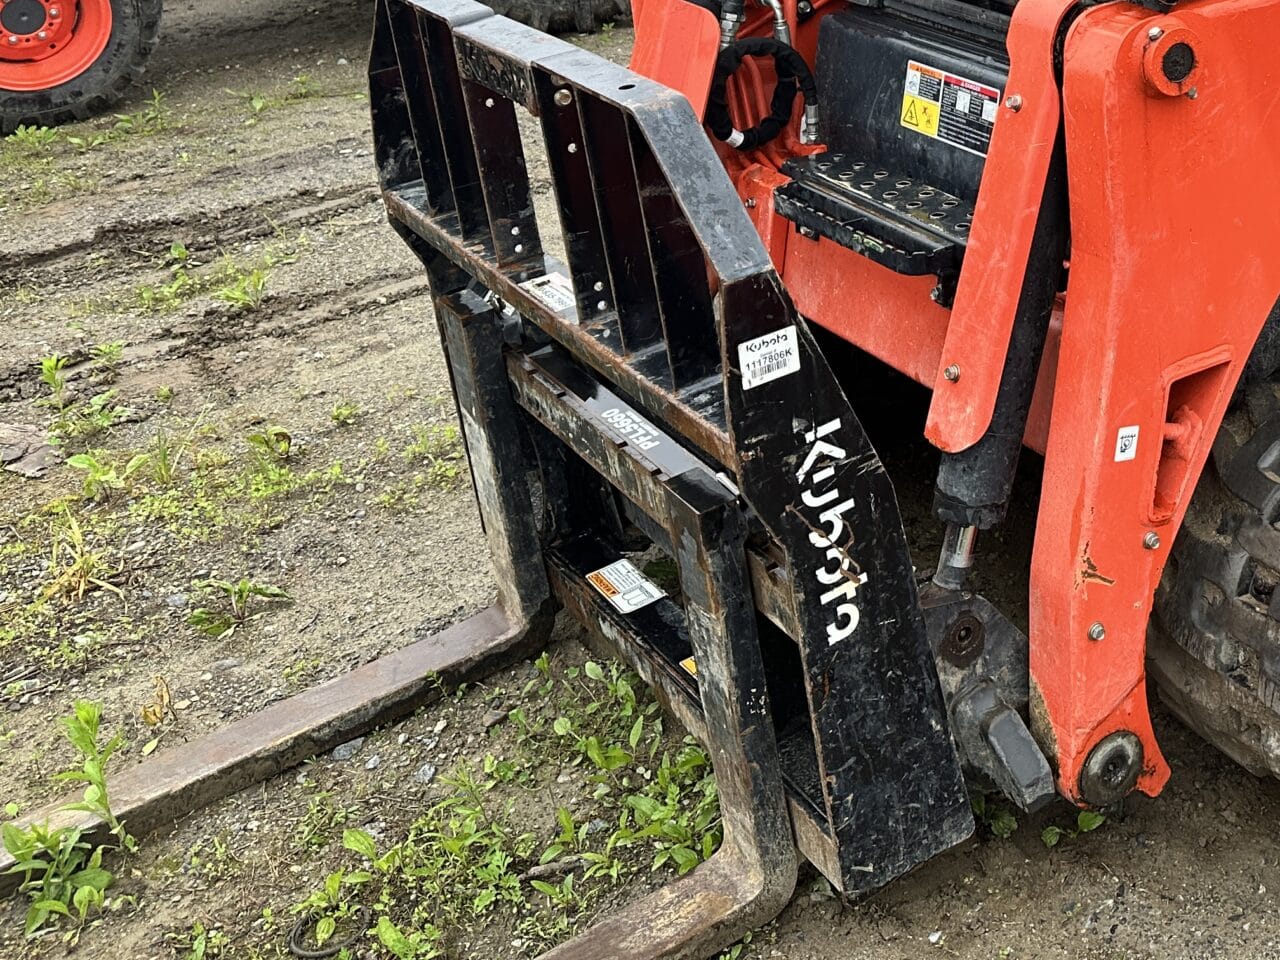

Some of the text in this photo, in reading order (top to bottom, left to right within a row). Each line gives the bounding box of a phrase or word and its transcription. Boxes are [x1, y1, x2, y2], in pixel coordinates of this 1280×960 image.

[745, 347, 793, 371] 1117806K
[746, 333, 788, 352] Kubota
[601, 408, 661, 451] PFL5660
[795, 417, 869, 647] Kubota
